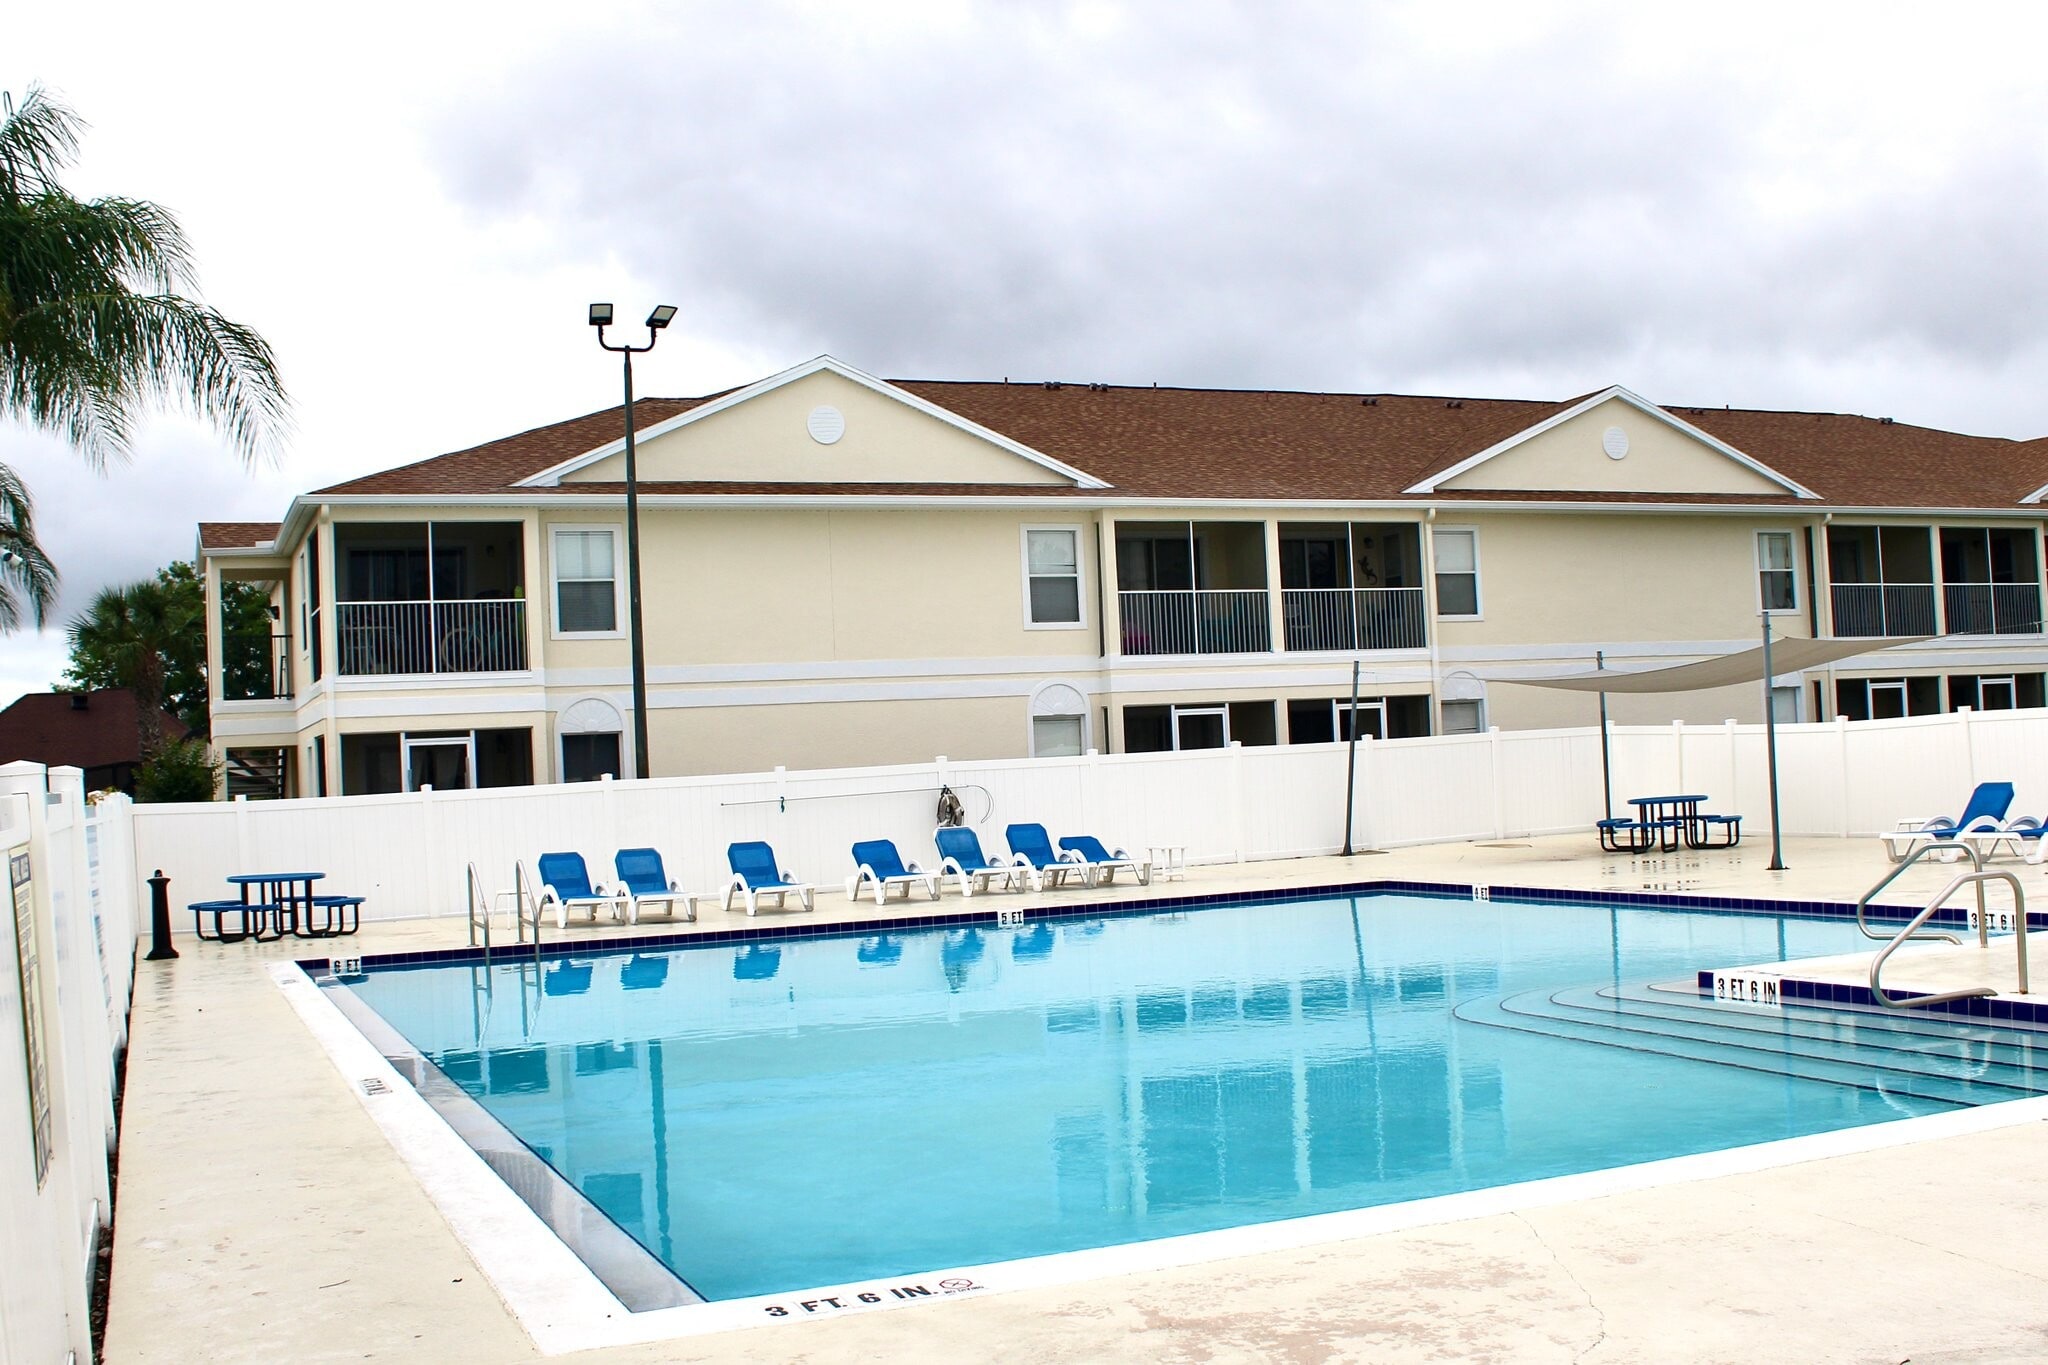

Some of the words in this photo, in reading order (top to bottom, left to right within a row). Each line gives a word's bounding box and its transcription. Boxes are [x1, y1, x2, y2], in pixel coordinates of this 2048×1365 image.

[764, 1305, 789, 1317] 3
[800, 1297, 848, 1312] FT.
[857, 1292, 882, 1304] 6
[890, 1285, 939, 1299] IN.
